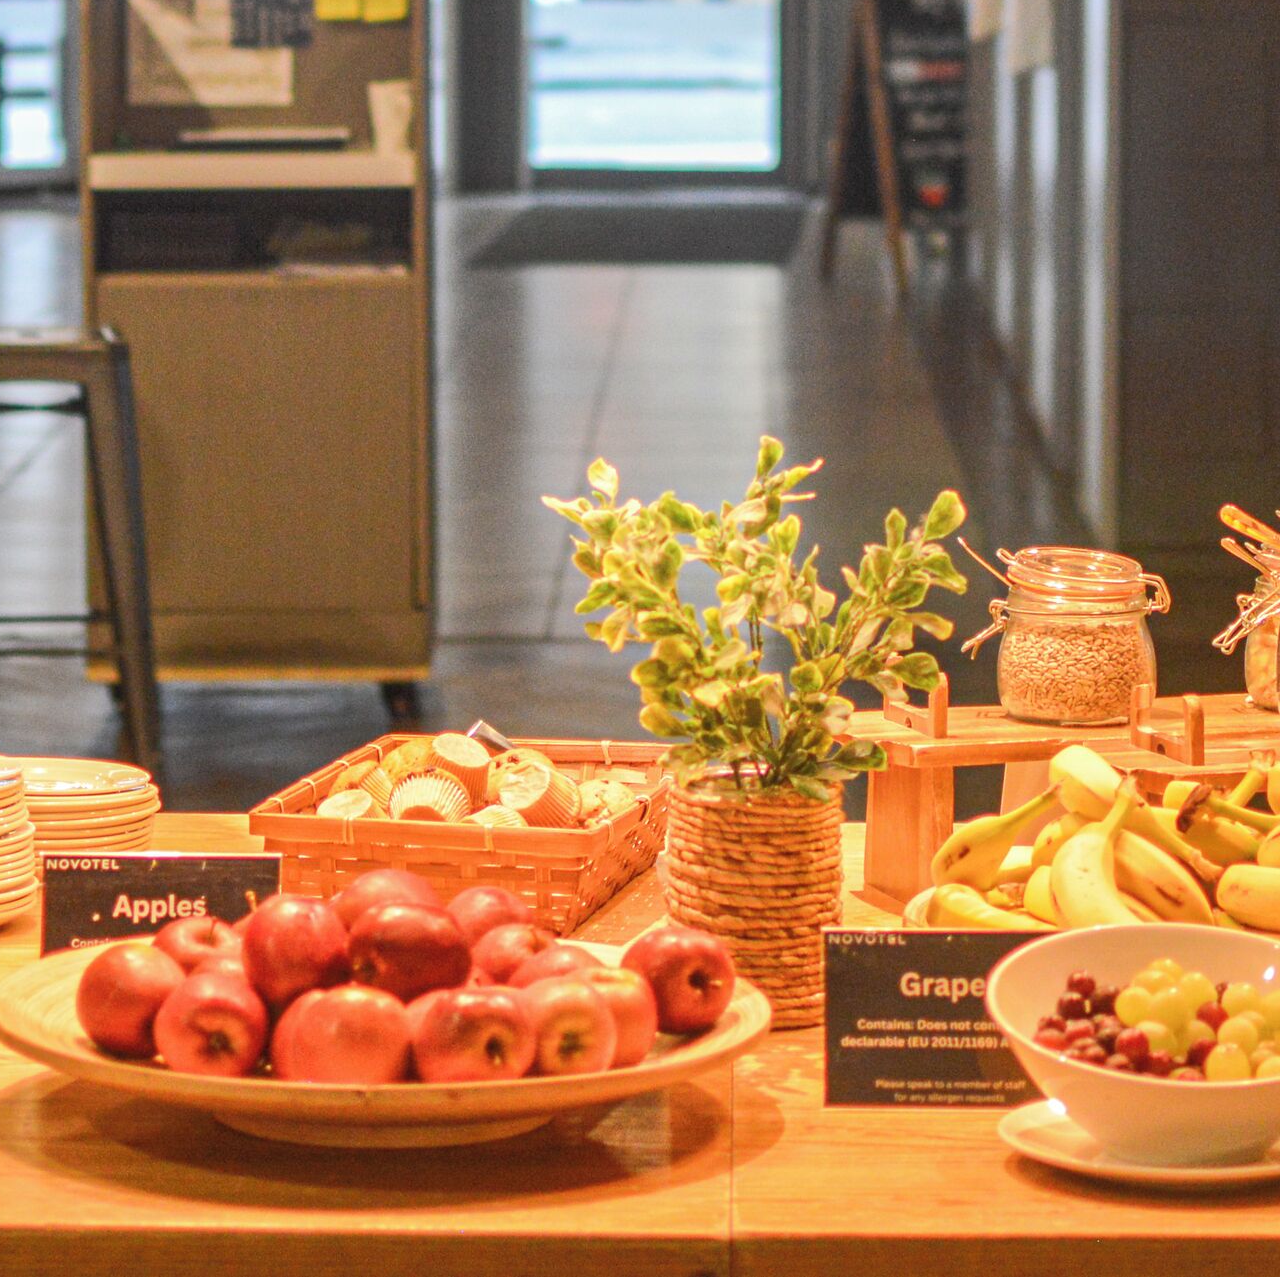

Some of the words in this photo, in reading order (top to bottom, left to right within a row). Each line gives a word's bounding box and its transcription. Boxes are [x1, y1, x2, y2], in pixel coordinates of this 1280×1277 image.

[46, 858, 120, 871] NOVOTEL
[112, 893, 207, 924] Apples
[829, 934, 907, 946] NOVOTEL
[900, 971, 987, 1004] Grape
[857, 1018, 914, 1031] Contains:
[916, 1019, 948, 1031] Does
[950, 1020, 970, 1031] not
[840, 1035, 905, 1048] declarable
[907, 1036, 929, 1049] (EU
[931, 1036, 998, 1049] 2011/1169)
[875, 1079, 907, 1089] Please
[907, 1080, 933, 1091] speak
[935, 1080, 945, 1089] to
[954, 1080, 991, 1089] member
[993, 1080, 1003, 1089] of
[1004, 1080, 1026, 1089] staff
[894, 1093, 908, 1102] for
[909, 1094, 926, 1103] any
[928, 1093, 963, 1104] allergen
[965, 1094, 1005, 1104] requests
